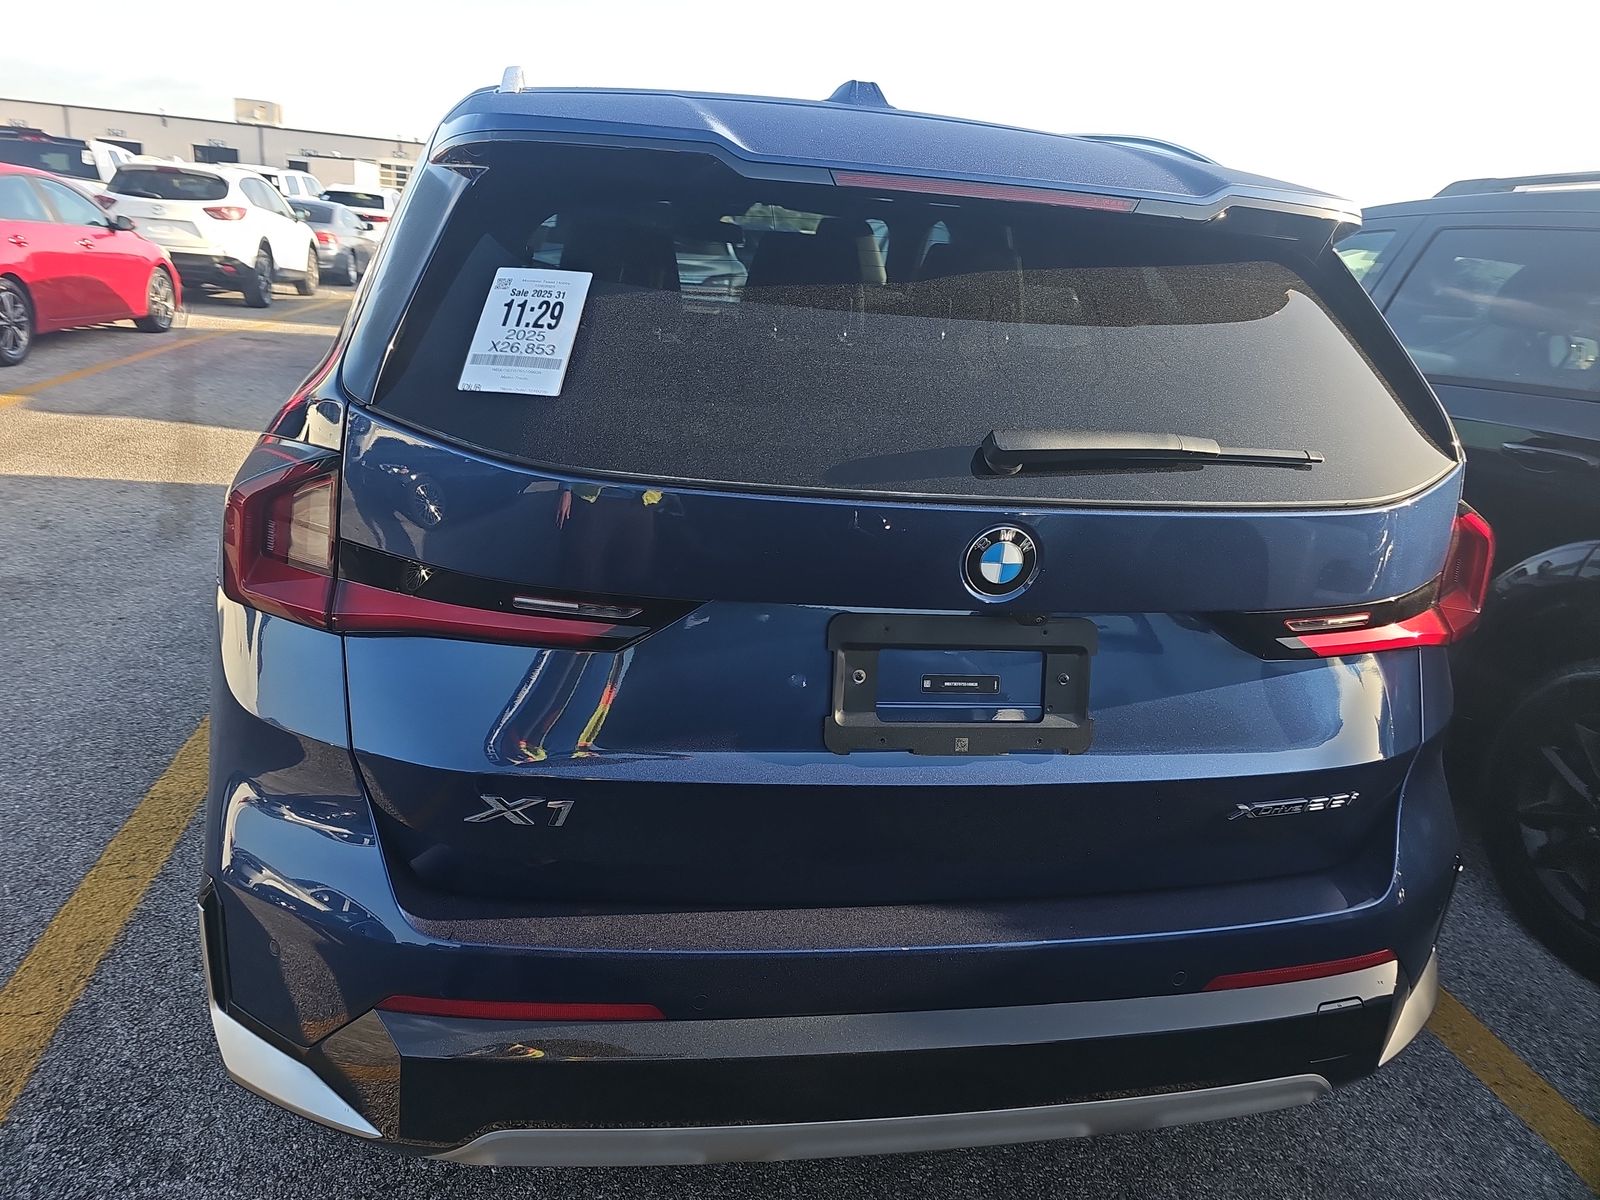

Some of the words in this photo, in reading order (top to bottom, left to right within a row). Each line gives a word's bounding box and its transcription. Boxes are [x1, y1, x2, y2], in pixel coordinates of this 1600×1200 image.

[510, 288, 529, 297] Sale
[531, 289, 553, 299] 2025
[554, 291, 566, 299] 31
[501, 299, 565, 330] 11:29
[505, 329, 546, 342] 2025
[488, 340, 556, 356] X26.853
[463, 794, 575, 827] X1
